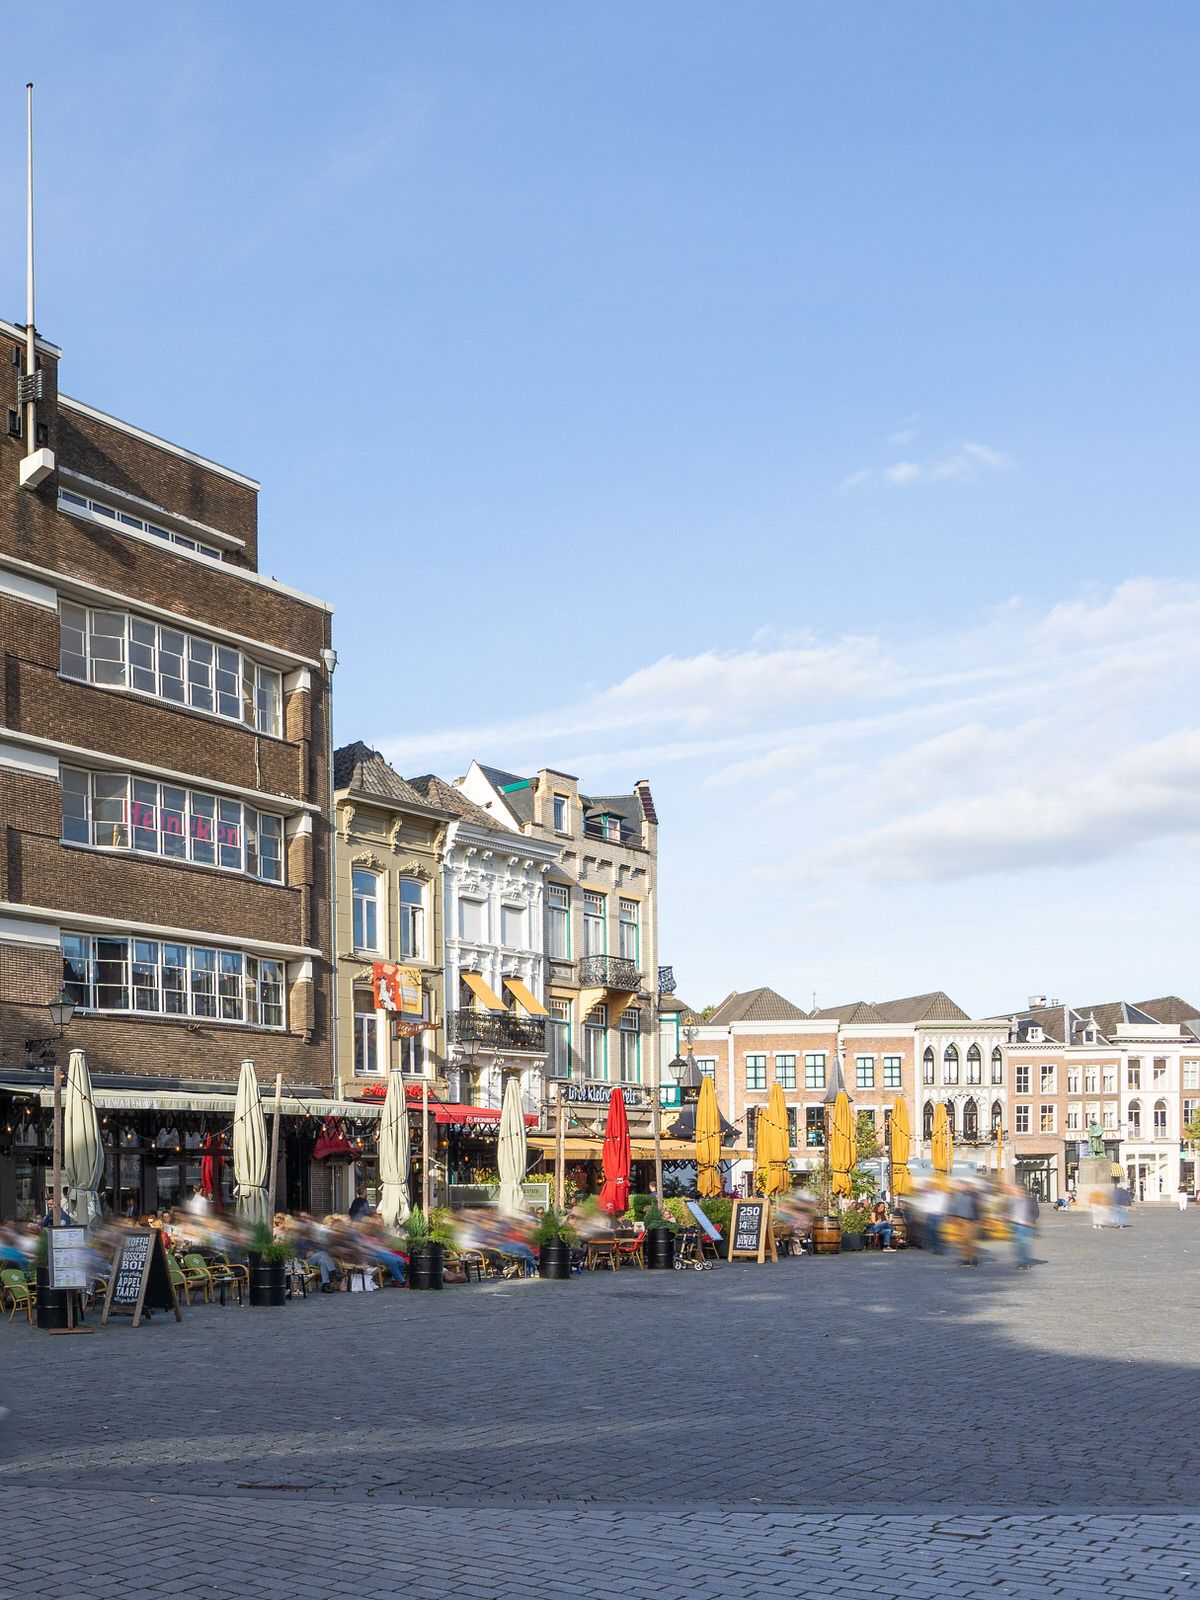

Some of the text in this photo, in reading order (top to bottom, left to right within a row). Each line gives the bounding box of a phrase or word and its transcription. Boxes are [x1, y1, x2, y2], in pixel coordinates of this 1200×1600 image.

[740, 1206, 760, 1216] 250
[120, 1260, 144, 1270] BOL
[117, 1277, 141, 1287] APPEL
[116, 1286, 140, 1297] TAART
